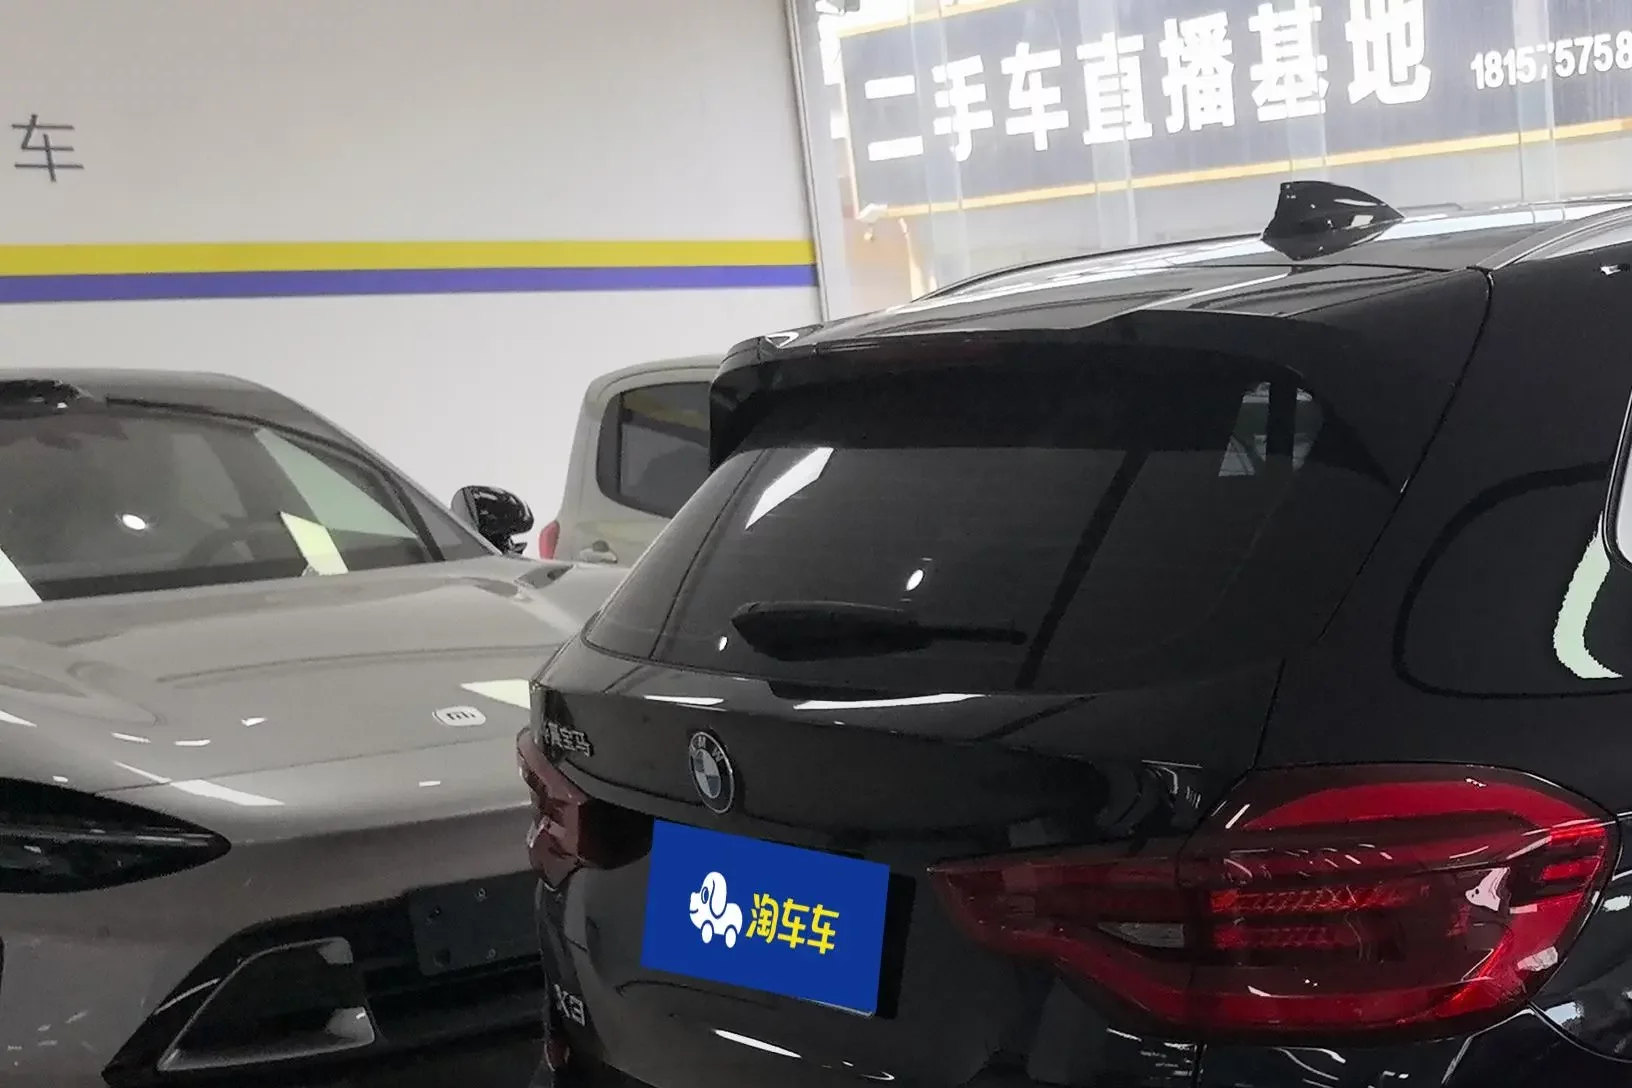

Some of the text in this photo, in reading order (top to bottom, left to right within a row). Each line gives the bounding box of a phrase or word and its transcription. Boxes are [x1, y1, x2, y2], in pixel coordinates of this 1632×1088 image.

[864, 0, 1432, 162] 二手车直播基地
[10, 113, 85, 183] 车
[553, 983, 586, 1027] X3
